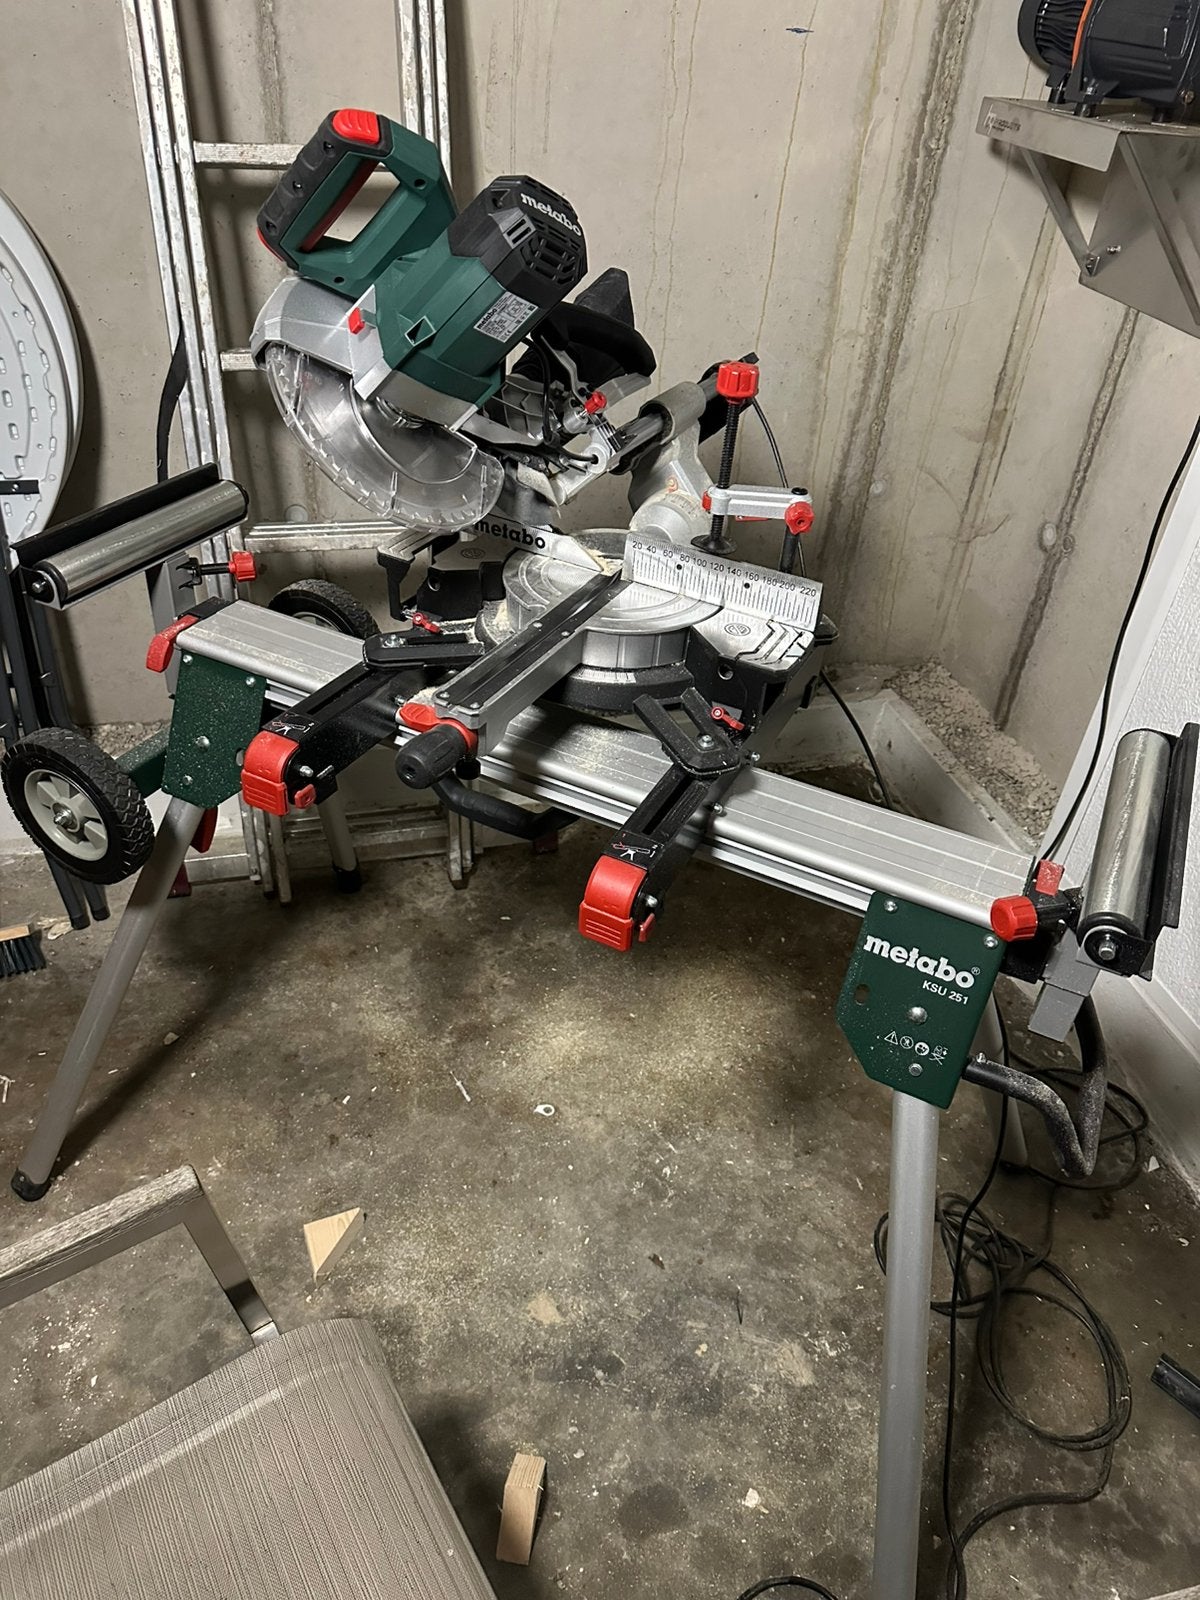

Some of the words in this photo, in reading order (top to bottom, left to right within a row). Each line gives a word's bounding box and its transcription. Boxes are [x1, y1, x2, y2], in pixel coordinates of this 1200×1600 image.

[520, 193, 582, 237] metabo
[477, 308, 498, 329] metabo
[475, 520, 546, 549] metabo
[632, 540, 643, 550] 20
[646, 545, 657, 554] 40
[663, 549, 673, 559] 60
[680, 553, 690, 563] 80
[693, 557, 707, 568] 100
[710, 562, 724, 572] 120
[727, 566, 742, 577] 140
[745, 571, 759, 582] 160
[763, 576, 777, 587] 180
[779, 580, 796, 592] 200
[800, 586, 817, 598] 220
[863, 935, 975, 989] metabo
[922, 980, 948, 997] KSU
[948, 990, 969, 1005] 251
